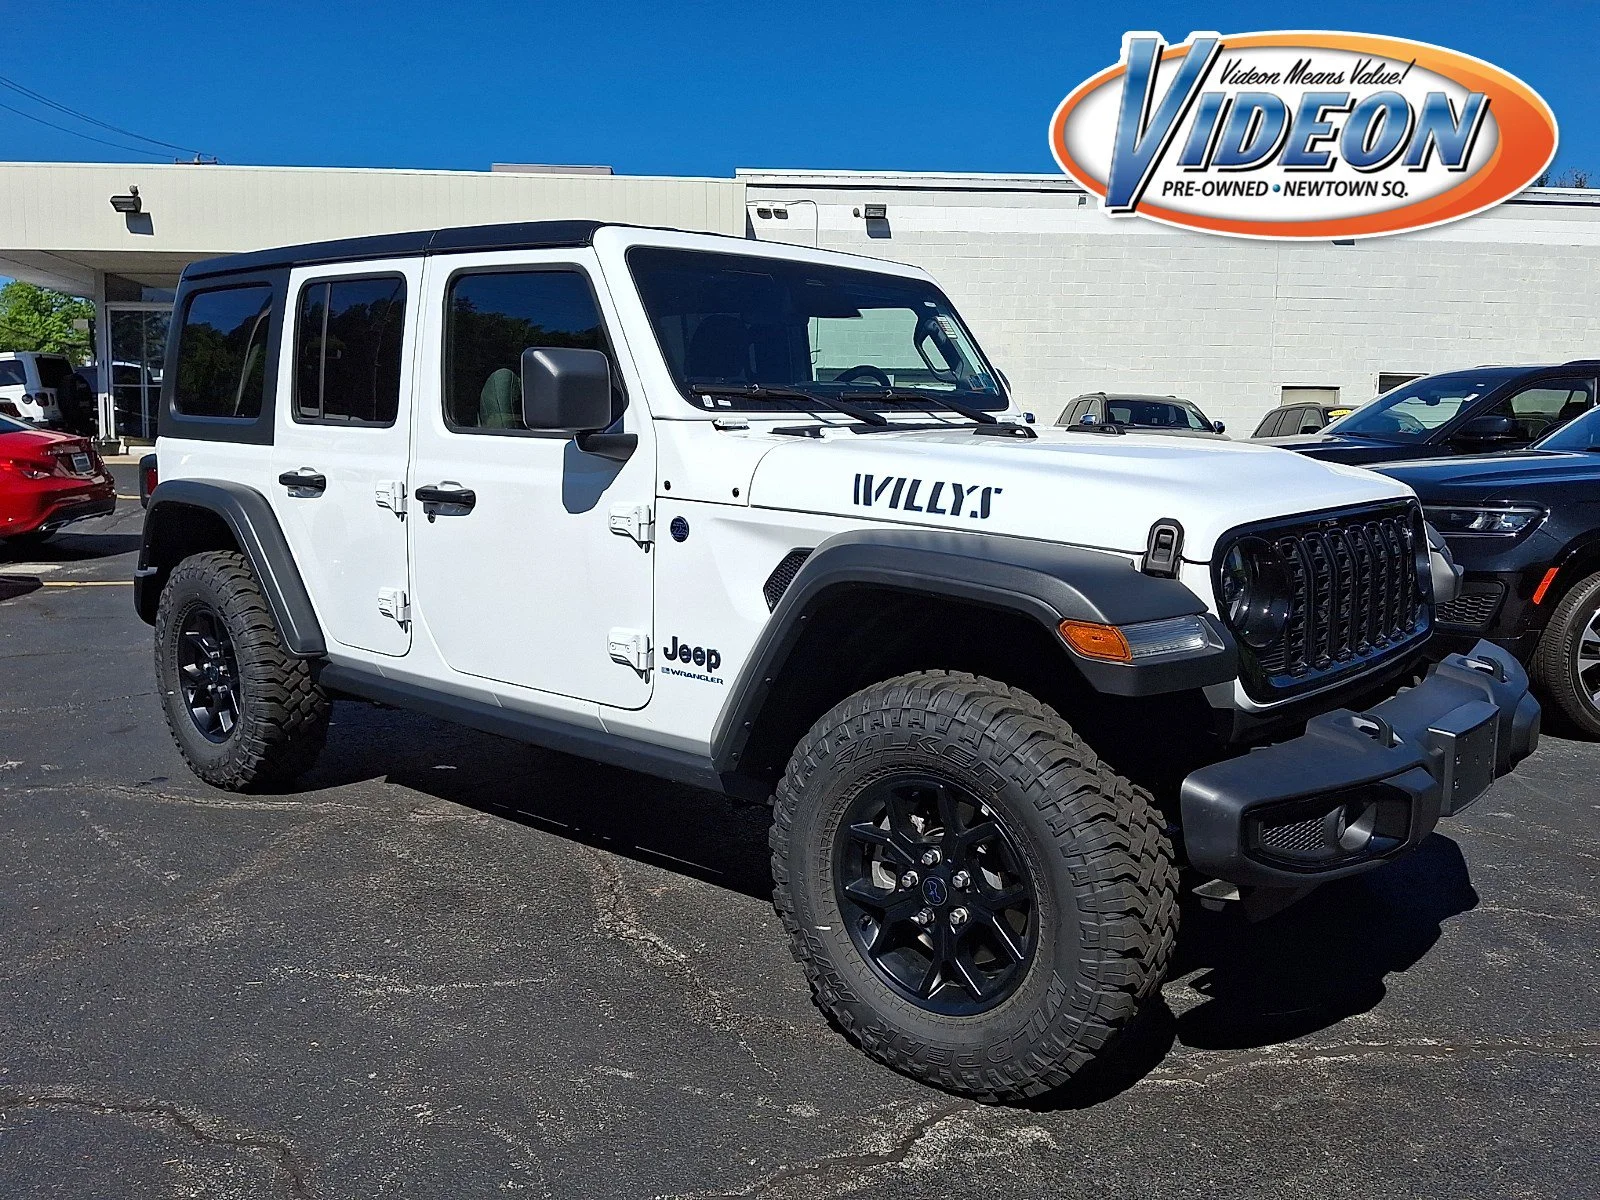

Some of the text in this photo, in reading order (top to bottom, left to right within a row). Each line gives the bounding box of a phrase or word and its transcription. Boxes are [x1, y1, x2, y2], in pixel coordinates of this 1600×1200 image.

[853, 473, 1003, 519] WILLYS
[663, 636, 722, 673] Jeep
[671, 668, 724, 685] WRANGLER
[830, 732, 1008, 792] FALKEN
[866, 970, 1068, 1069] WILDPEAK
